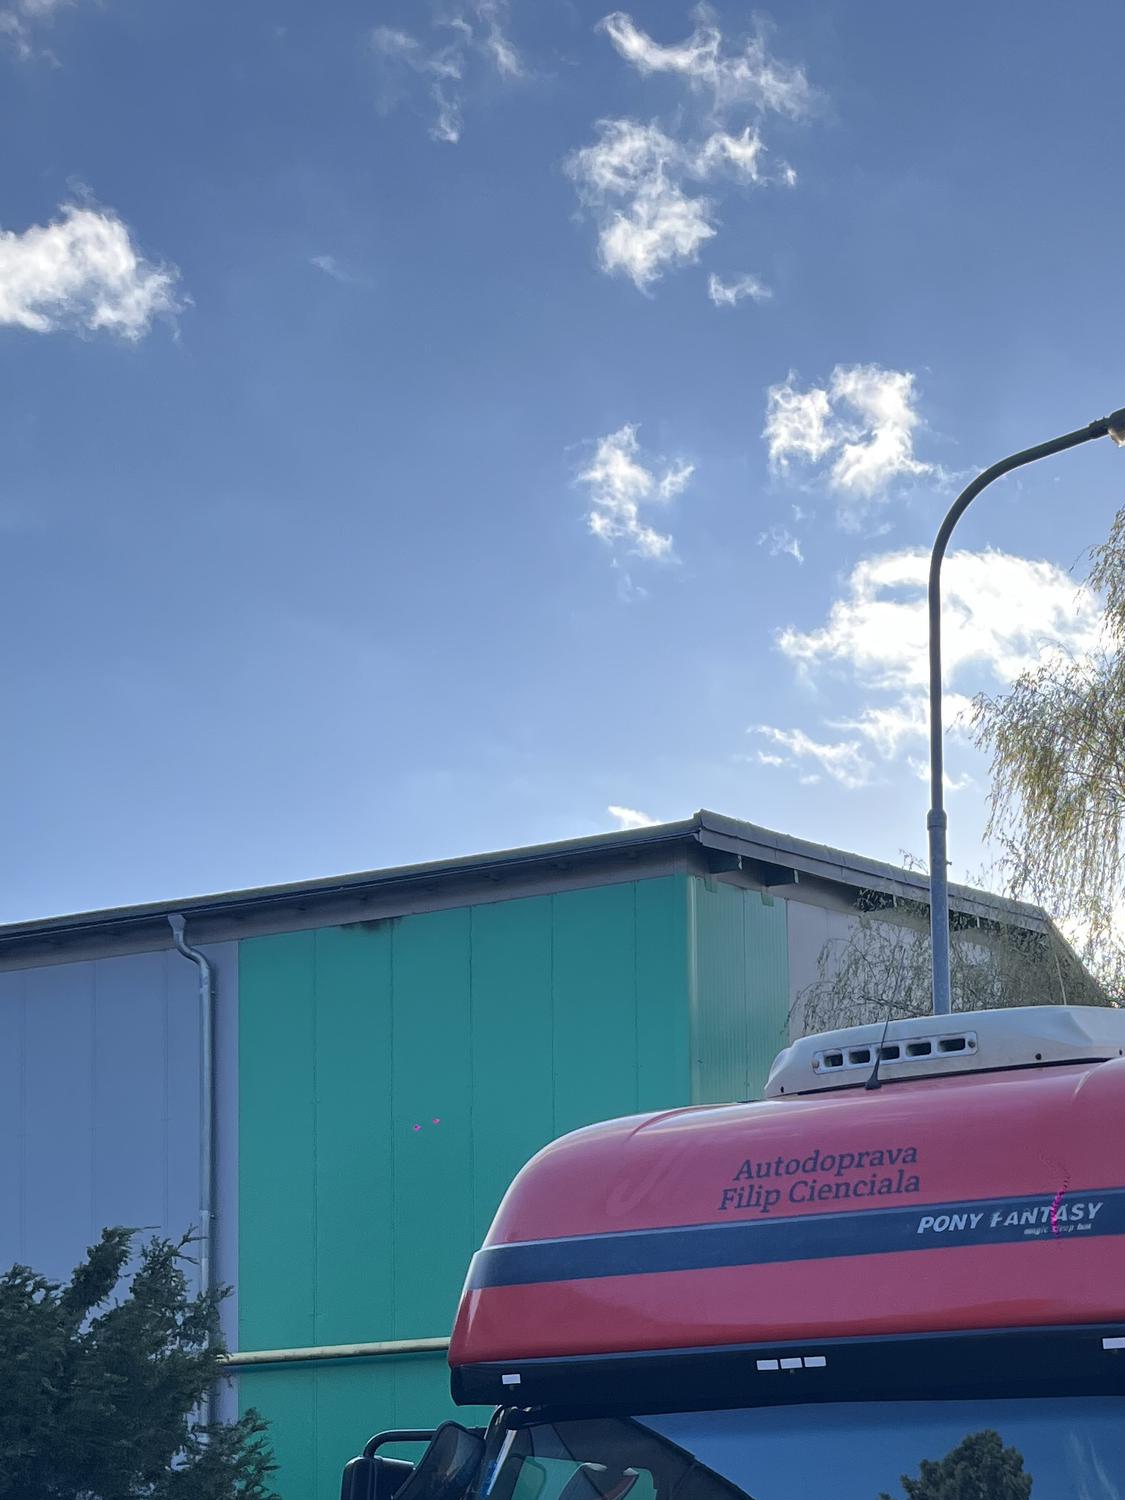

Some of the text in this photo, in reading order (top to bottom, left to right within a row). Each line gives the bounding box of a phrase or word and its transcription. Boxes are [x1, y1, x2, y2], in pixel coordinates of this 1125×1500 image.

[732, 1146, 918, 1182] Autodoprava
[718, 1169, 921, 1213] Filip Cienciala
[917, 1202, 1104, 1234] PONY FANTASY
